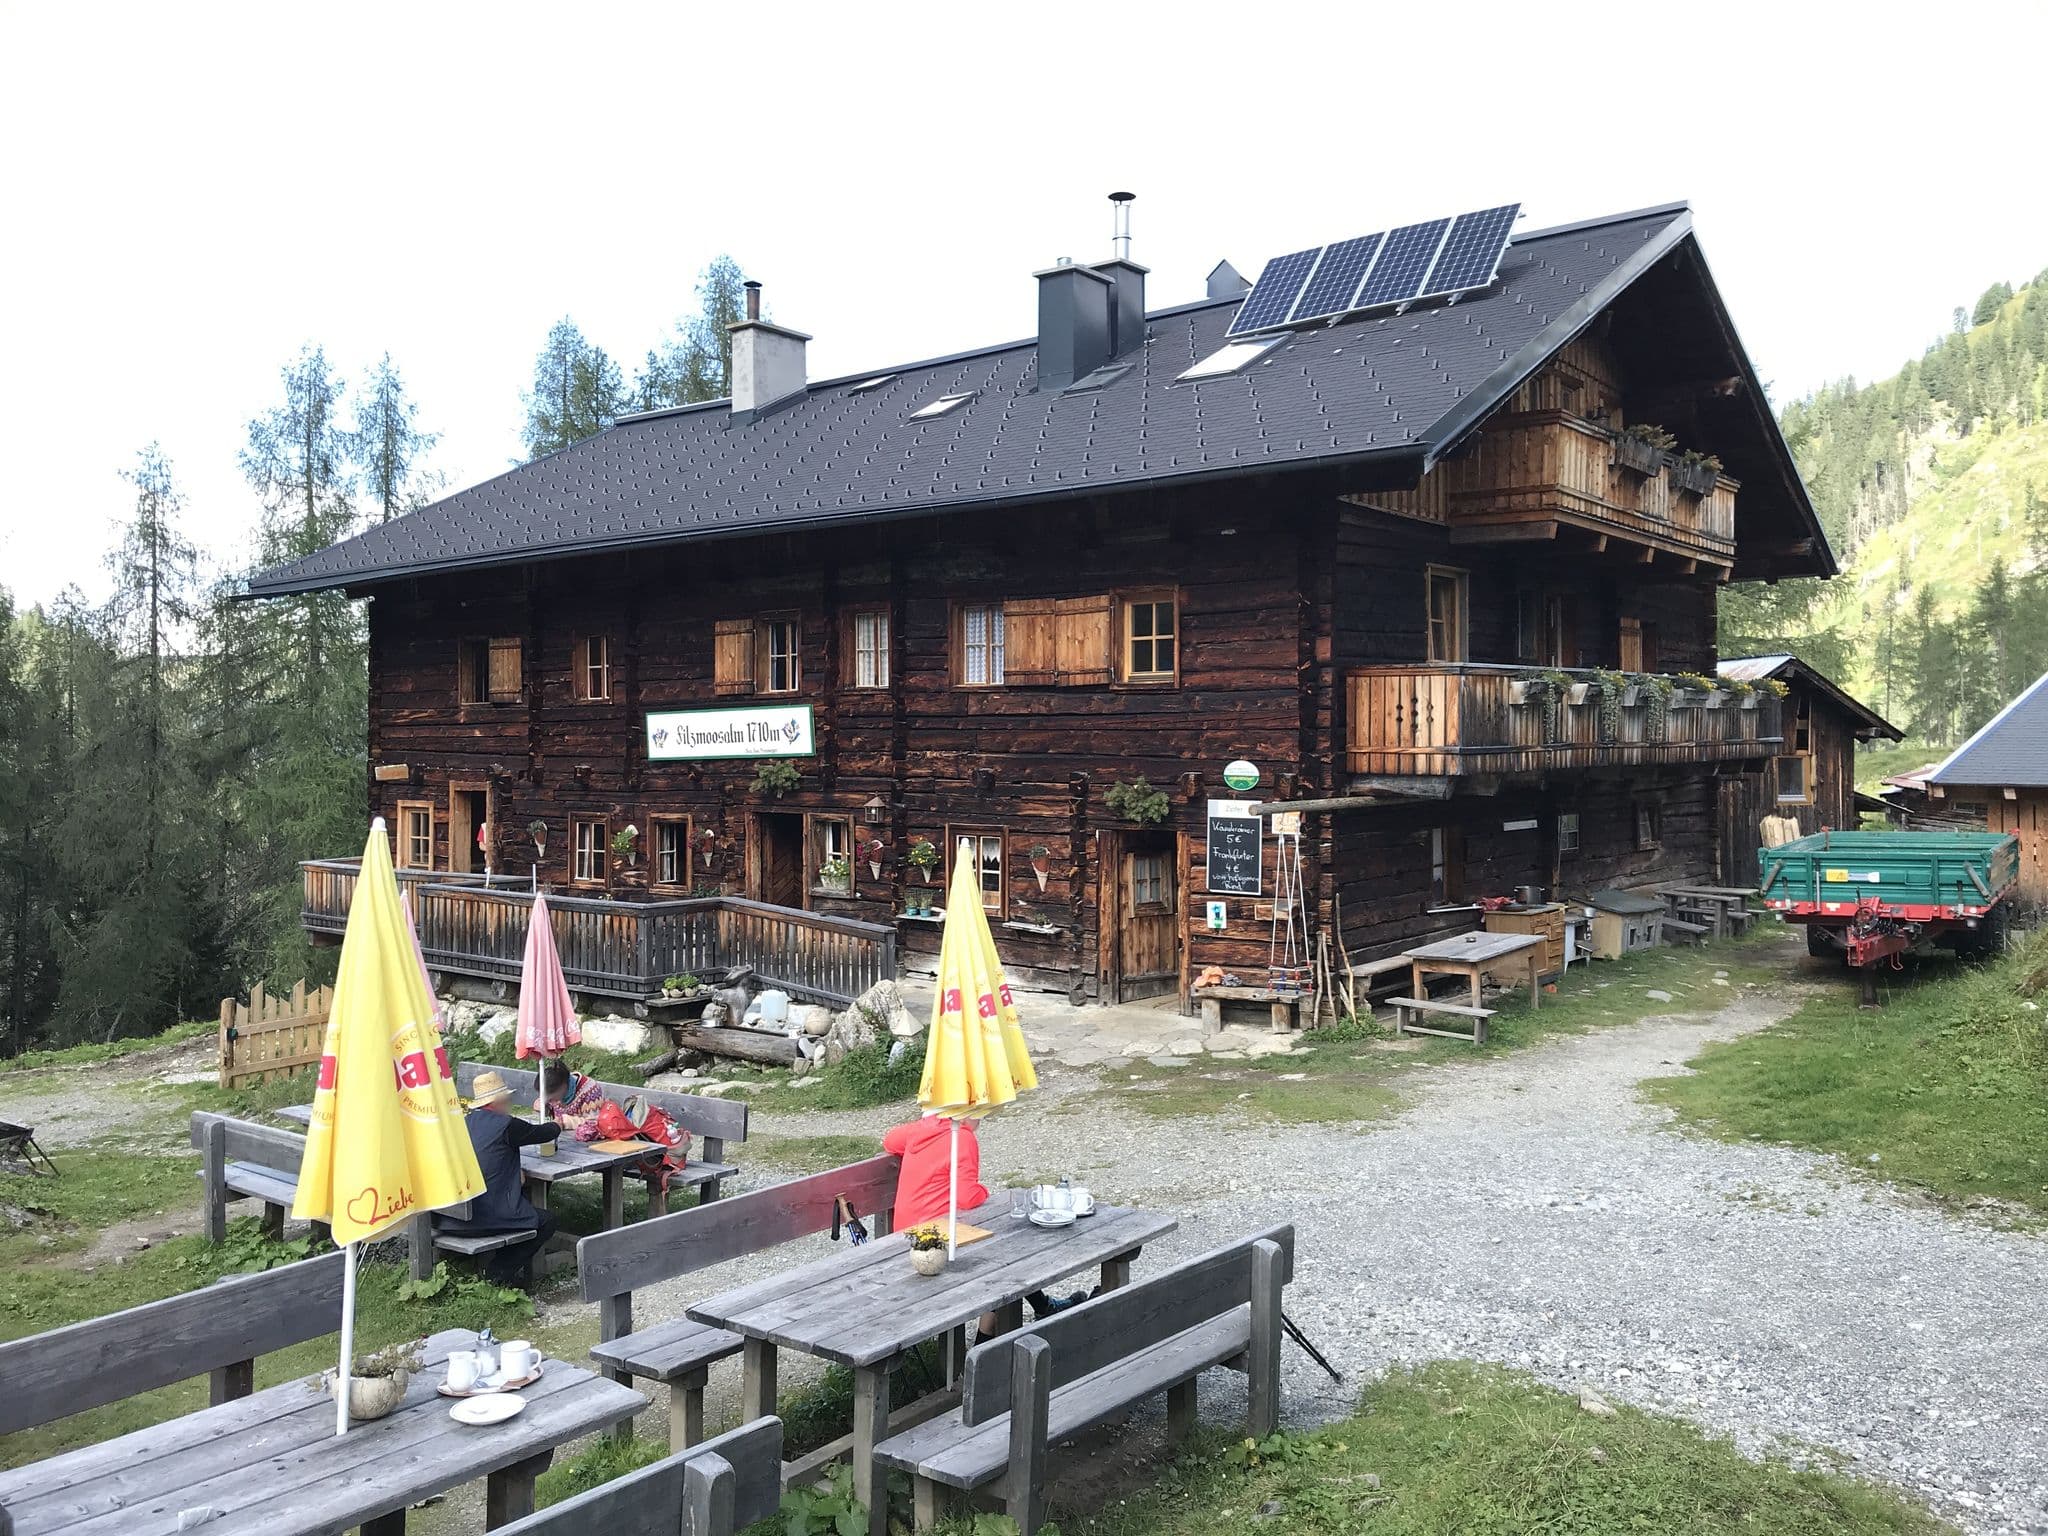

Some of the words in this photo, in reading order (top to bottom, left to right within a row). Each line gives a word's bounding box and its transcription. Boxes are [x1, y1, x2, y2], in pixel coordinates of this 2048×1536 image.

[676, 723, 744, 748] Filzmoosalm
[1212, 846, 1255, 861] Frankfurter
[395, 1030, 418, 1052] SINC
[403, 1096, 440, 1114] PREMIU
